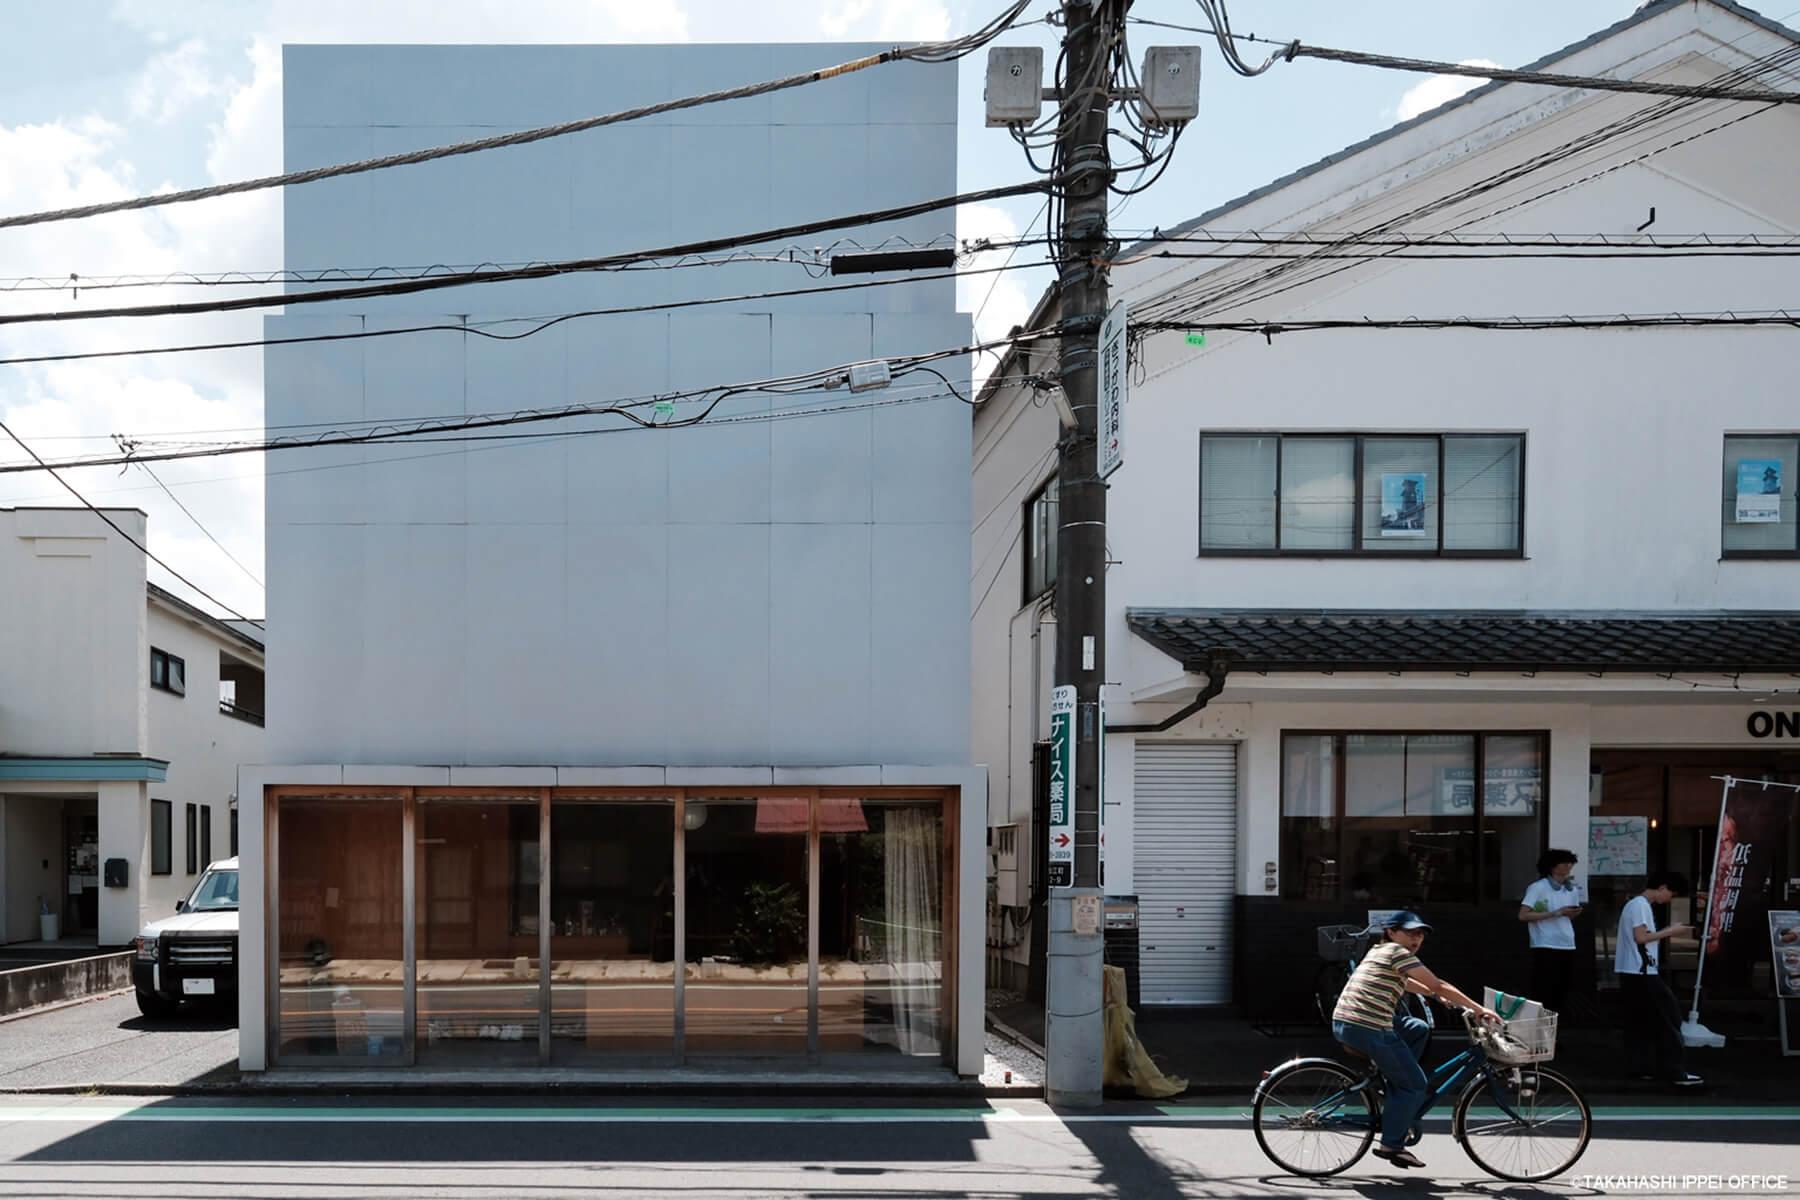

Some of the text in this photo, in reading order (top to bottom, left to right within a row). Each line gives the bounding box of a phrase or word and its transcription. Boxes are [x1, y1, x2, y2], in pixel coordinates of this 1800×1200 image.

[1747, 711, 1800, 738] ON
[1050, 717, 1065, 824] ナイス薬局
